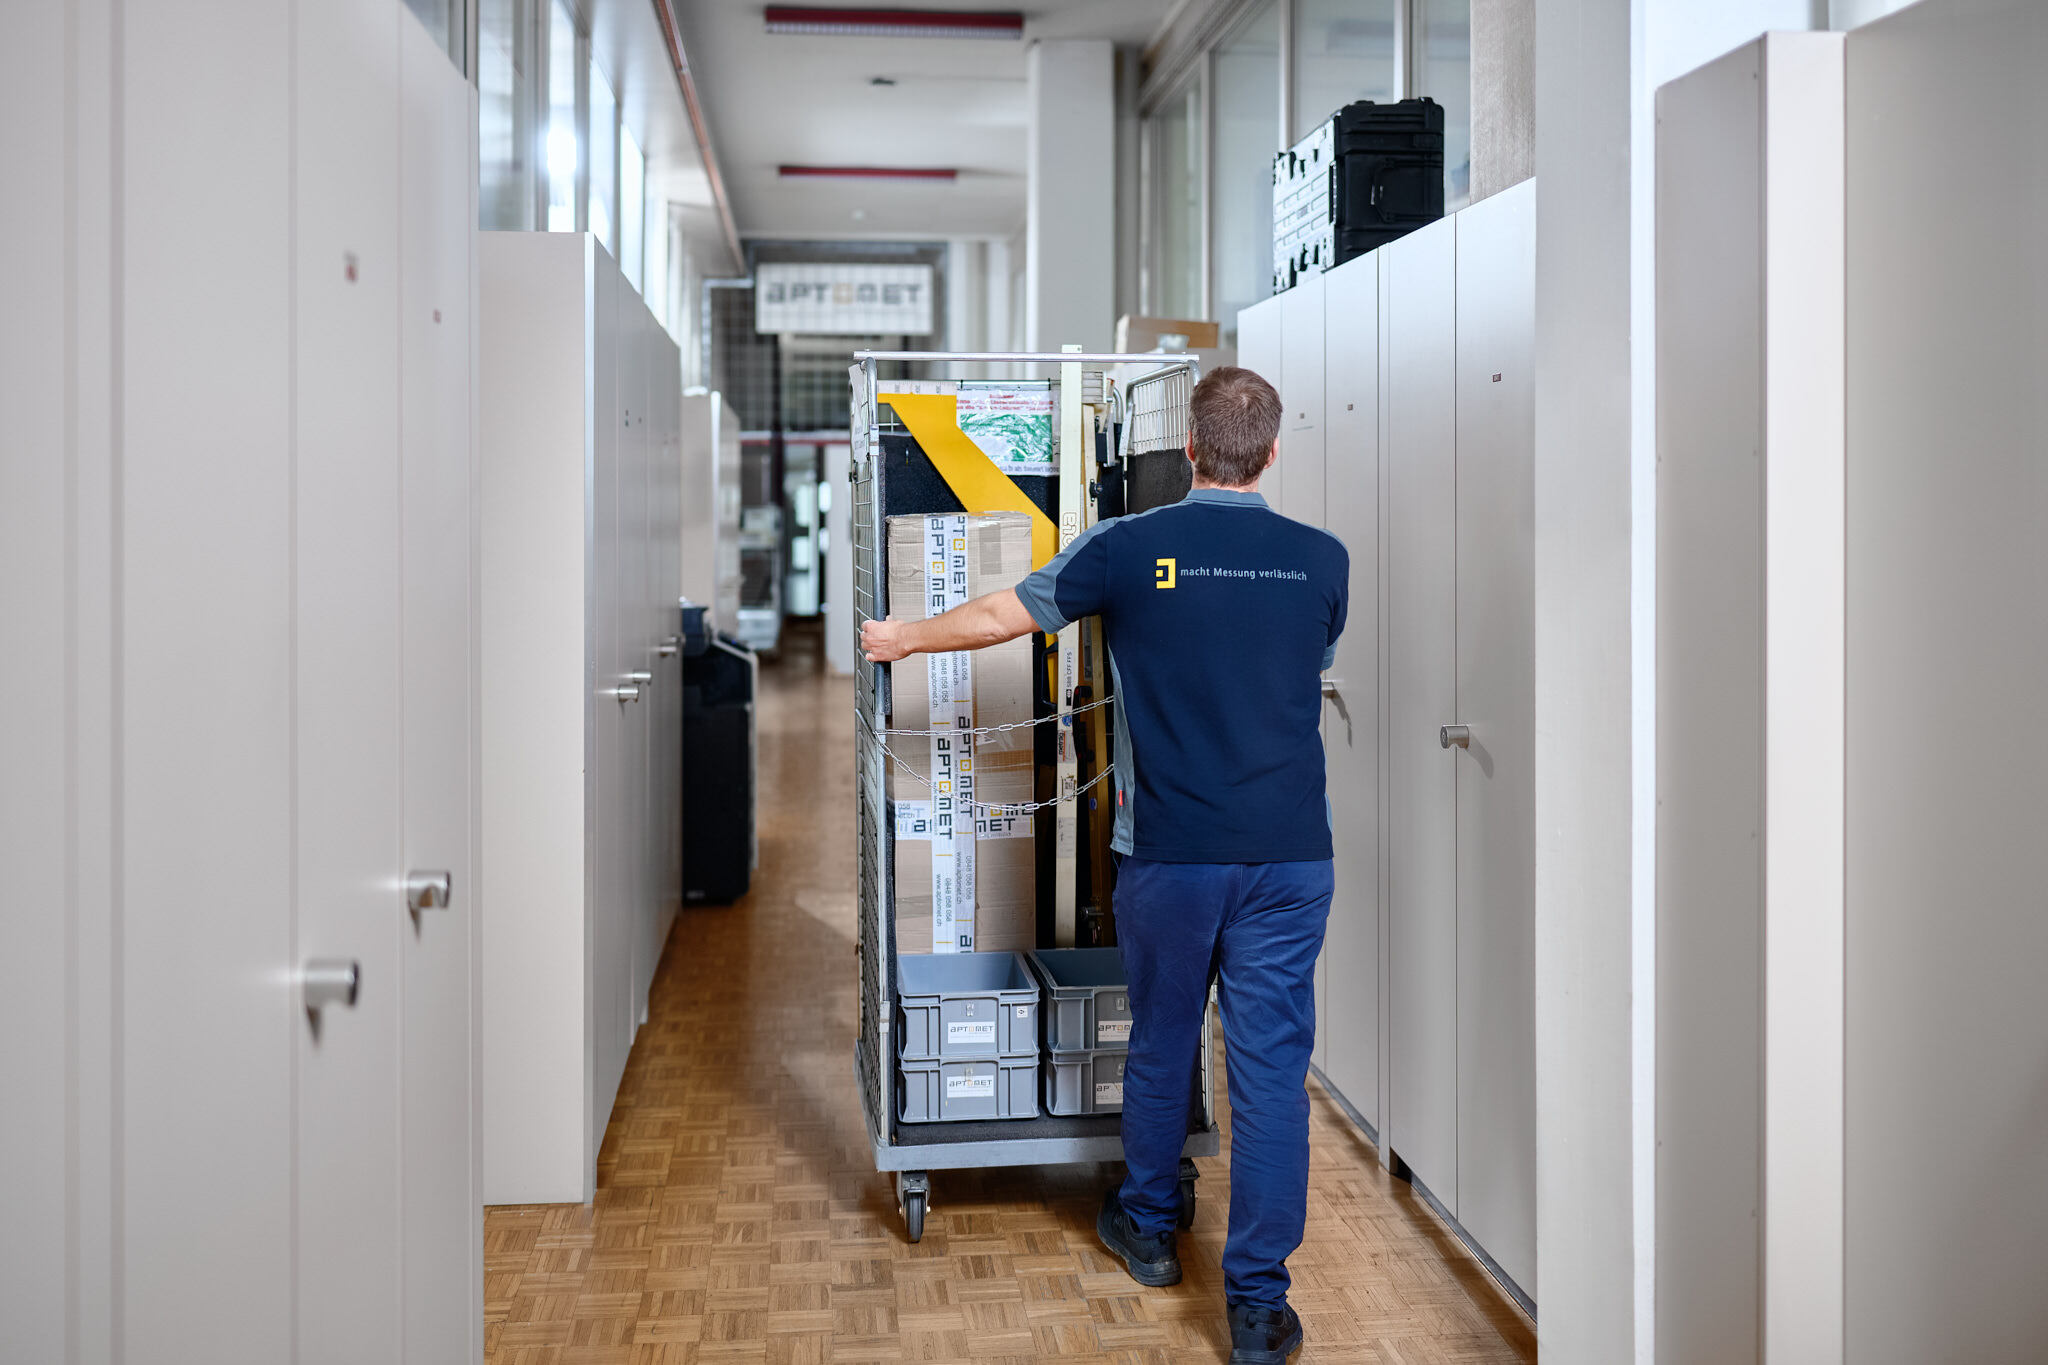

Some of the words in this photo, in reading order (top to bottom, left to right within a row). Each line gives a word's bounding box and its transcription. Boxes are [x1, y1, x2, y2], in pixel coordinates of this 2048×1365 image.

[1180, 567, 1210, 577] macht
[1213, 567, 1256, 580] Messung
[1258, 569, 1307, 581] verlässlich
